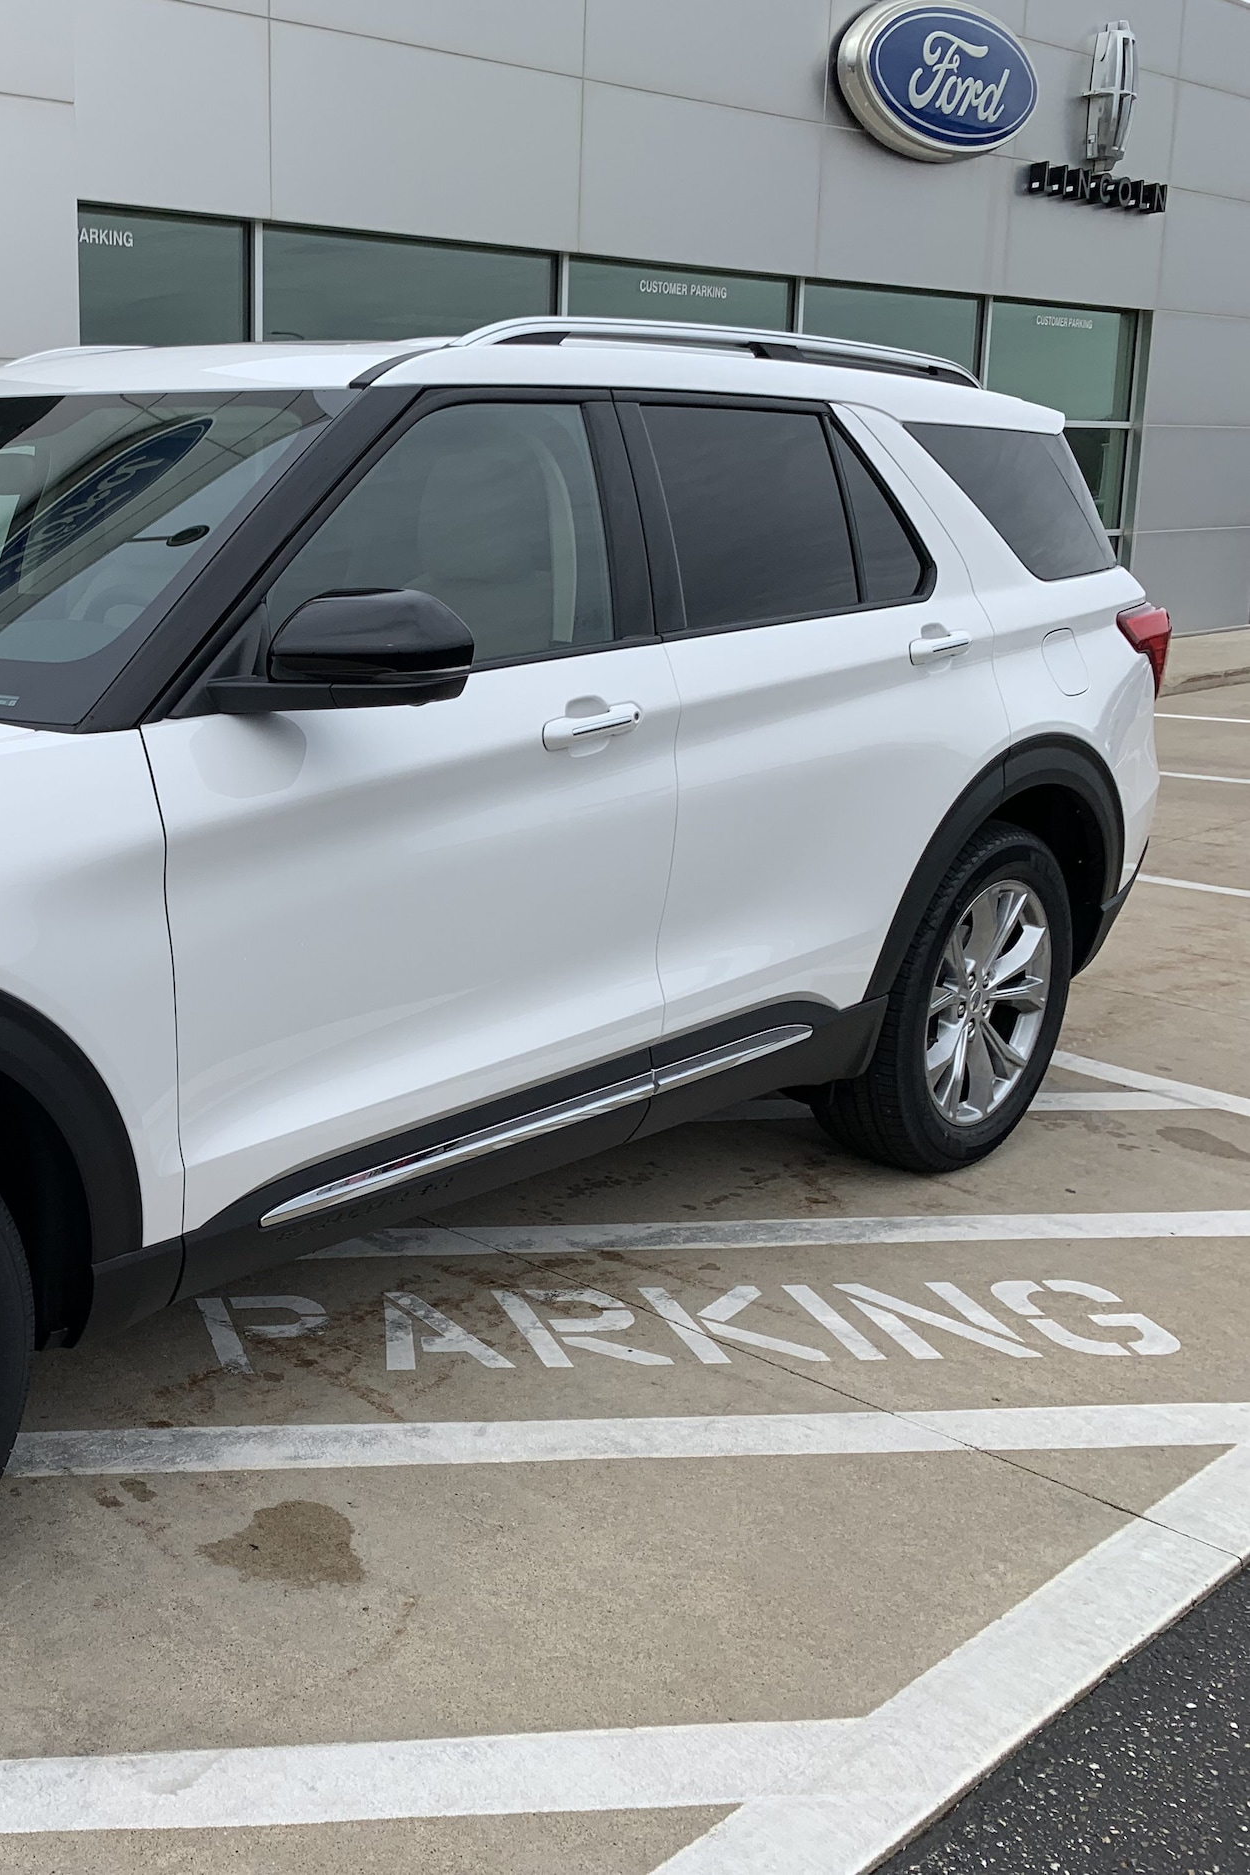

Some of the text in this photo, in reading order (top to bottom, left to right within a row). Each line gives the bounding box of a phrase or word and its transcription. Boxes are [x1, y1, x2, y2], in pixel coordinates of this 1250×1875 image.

[908, 31, 1011, 124] Ford
[1029, 161, 1168, 213] LINCOLN
[78, 227, 134, 247] ARKING
[639, 280, 728, 298] CUSTOMER PARKING
[1036, 315, 1093, 329] CUSTOMER PARKING
[194, 1279, 1181, 1374] PARKING
